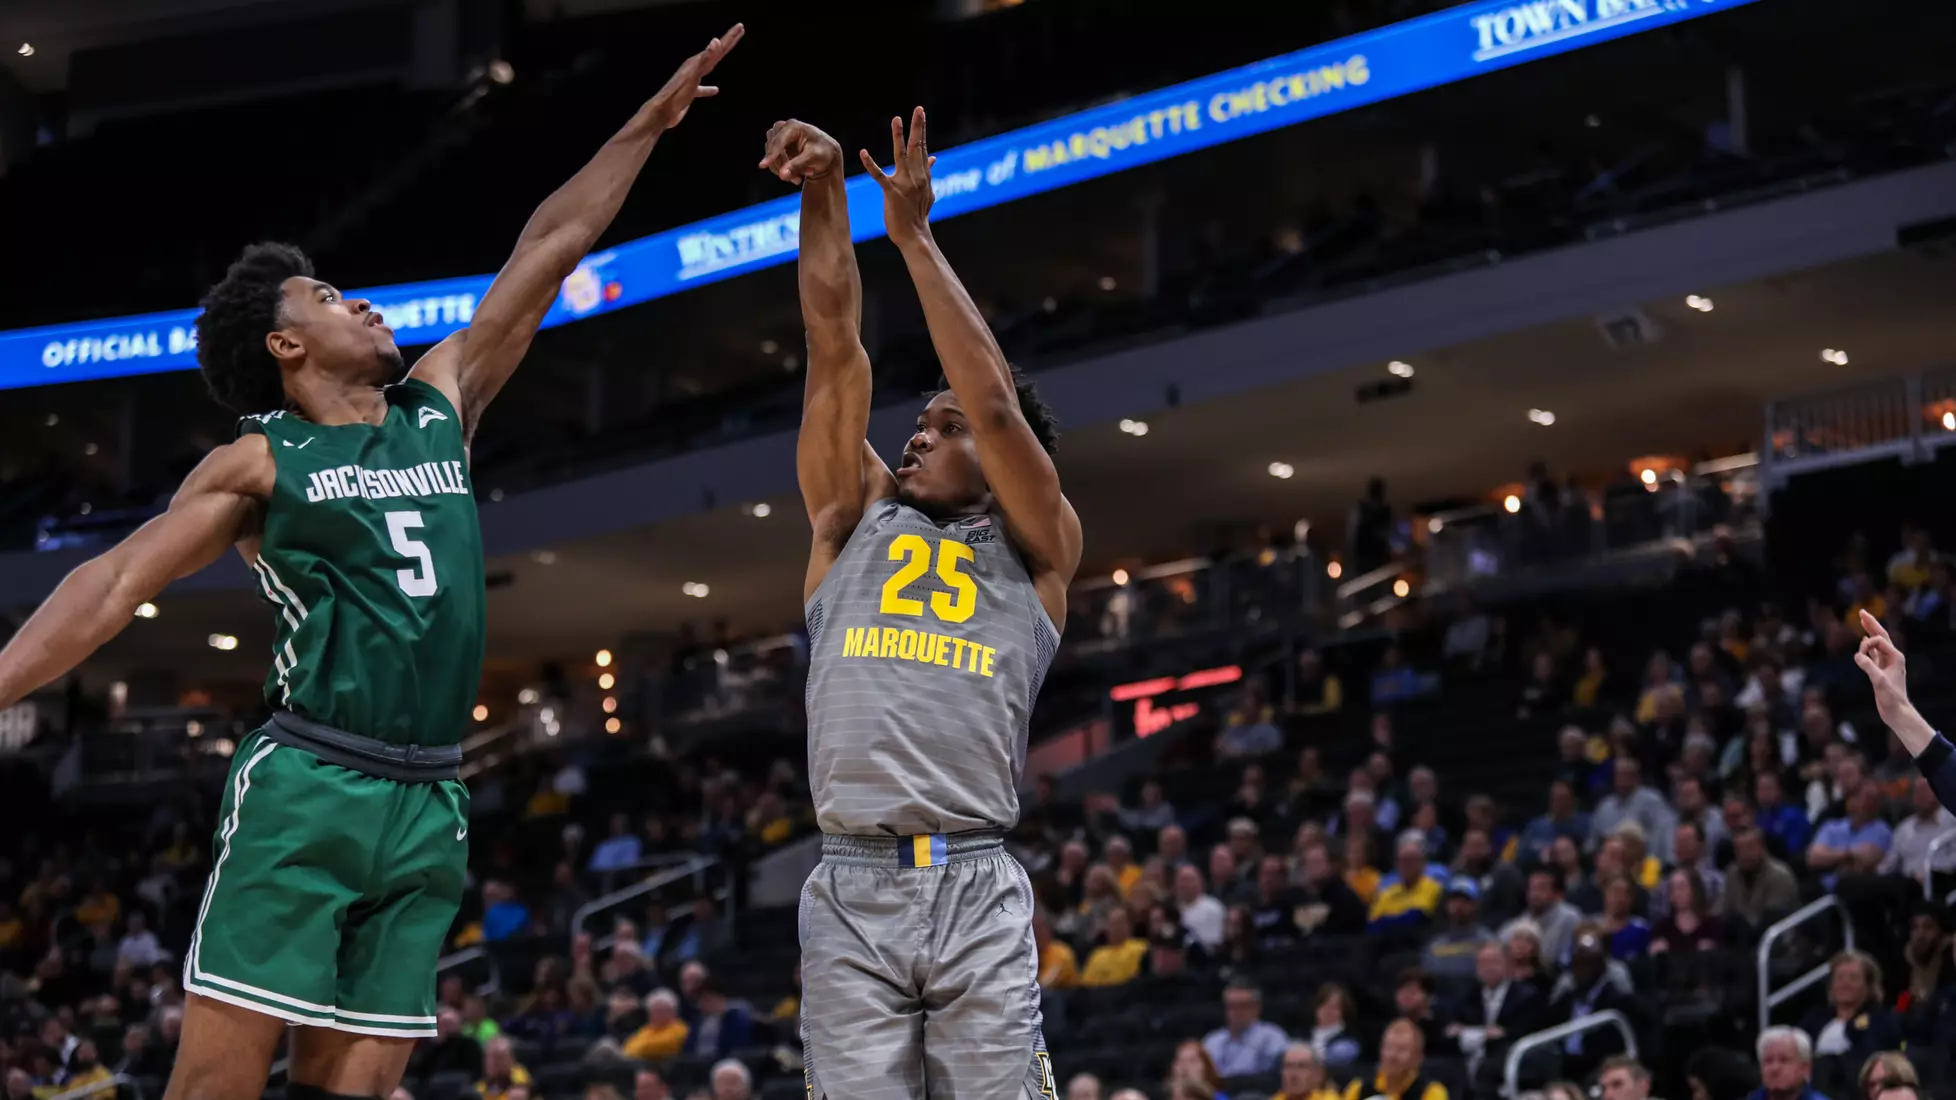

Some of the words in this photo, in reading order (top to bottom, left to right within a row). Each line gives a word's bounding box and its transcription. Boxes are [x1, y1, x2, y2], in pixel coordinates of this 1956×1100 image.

[1470, 0, 1588, 51] TOWN
[931, 168, 981, 203] ome
[986, 149, 1018, 185] of
[1023, 101, 1202, 173] MARQUETTE
[1208, 54, 1371, 122] CHECKING
[42, 331, 162, 368] OFFICIAL
[168, 326, 199, 355] BA
[370, 293, 475, 330] UETTE
[384, 511, 438, 597] 5
[880, 534, 978, 623] 25
[842, 627, 996, 677] MARQUETTE
